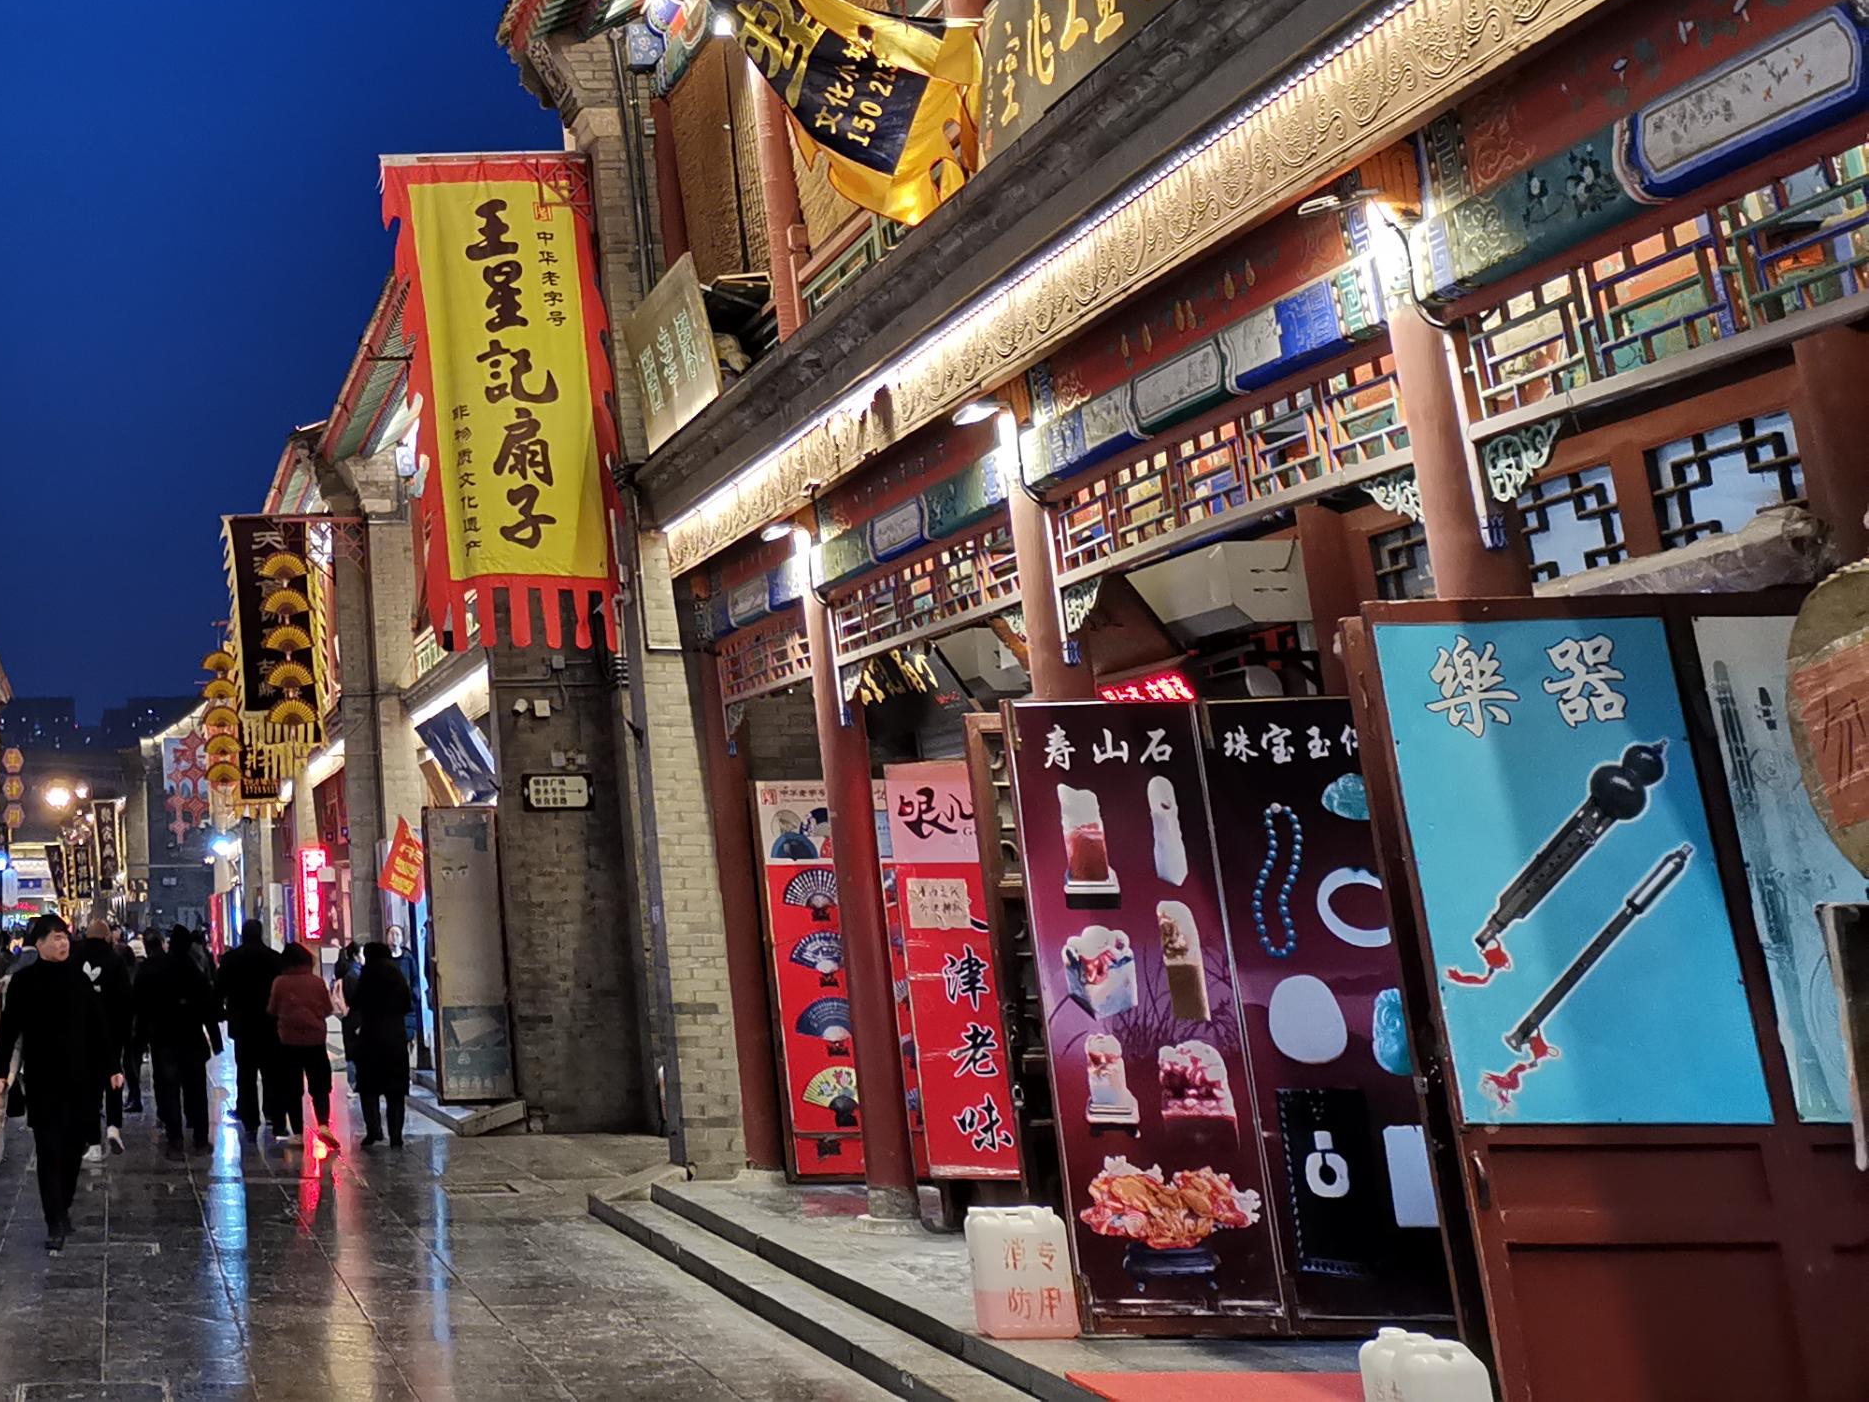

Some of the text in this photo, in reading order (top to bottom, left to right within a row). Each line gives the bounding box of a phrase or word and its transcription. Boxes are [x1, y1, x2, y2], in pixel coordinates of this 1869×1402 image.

[537, 231, 566, 326] 中华老字号
[465, 199, 559, 549] 王星記扇子
[452, 405, 482, 557] 非物质文化遗产
[1043, 725, 1173, 771] 寿山石
[943, 914, 1013, 1153] 津老味
